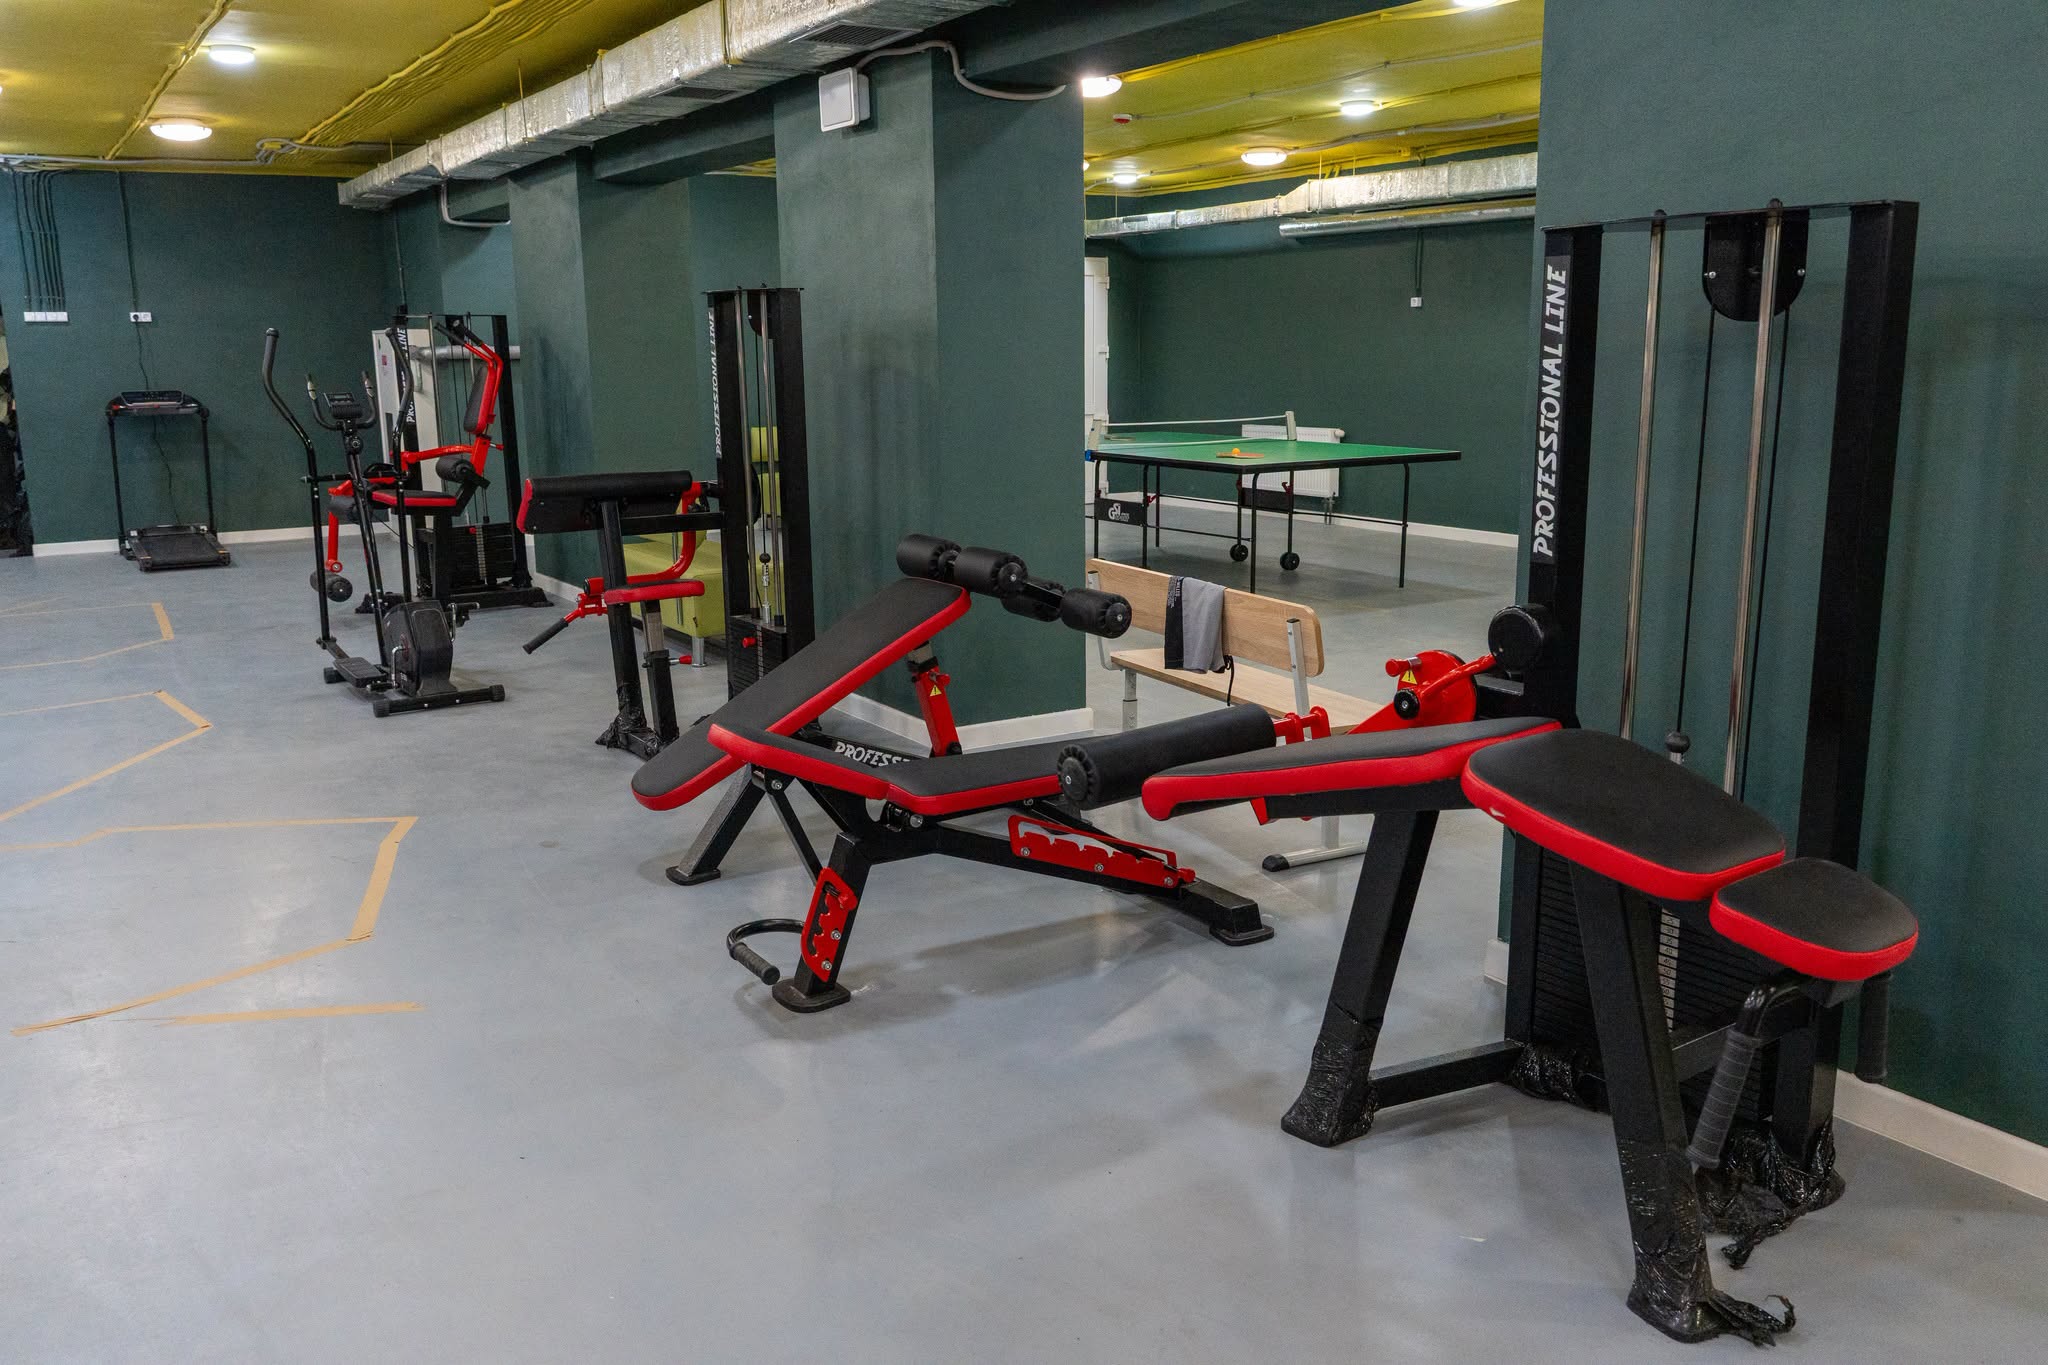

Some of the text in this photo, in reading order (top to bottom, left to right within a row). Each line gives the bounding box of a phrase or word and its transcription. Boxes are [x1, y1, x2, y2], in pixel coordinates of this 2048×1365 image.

[396, 327, 408, 351] LINE
[710, 349, 722, 456] PROFESSIONAL
[1532, 264, 1567, 557] PROFESSIONAL LINE
[834, 741, 911, 767] PROFES
